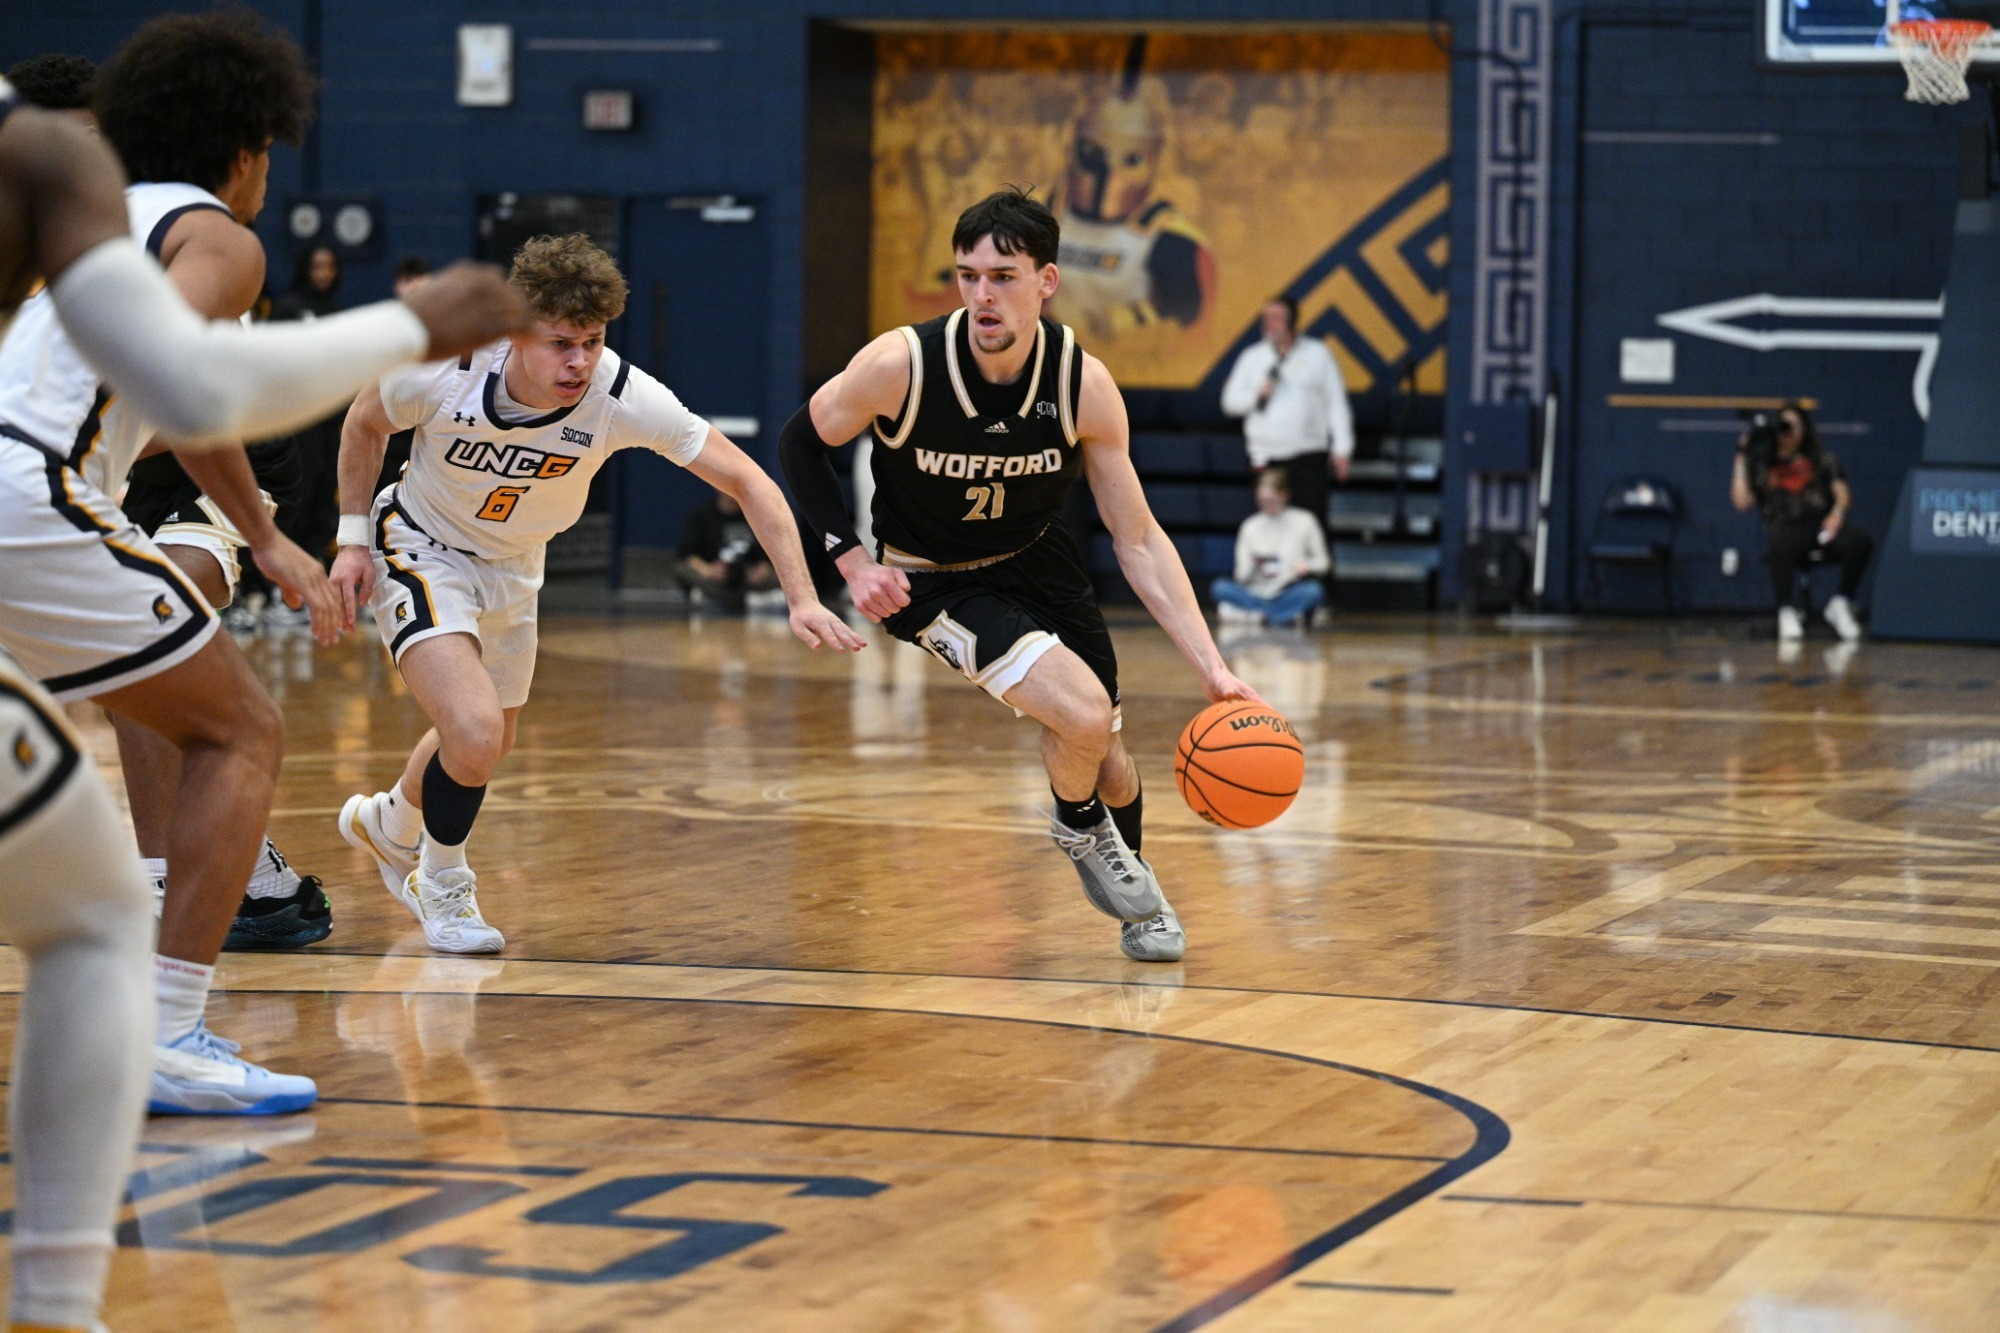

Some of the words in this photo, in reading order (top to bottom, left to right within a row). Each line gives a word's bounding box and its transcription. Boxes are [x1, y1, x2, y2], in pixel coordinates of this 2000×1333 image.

[560, 426, 594, 449] SOCON
[444, 437, 581, 480] UNCG
[914, 447, 1062, 480] WOFFORD
[475, 485, 531, 523] 6
[961, 482, 1005, 521] 21
[1932, 510, 2000, 538] DENT
